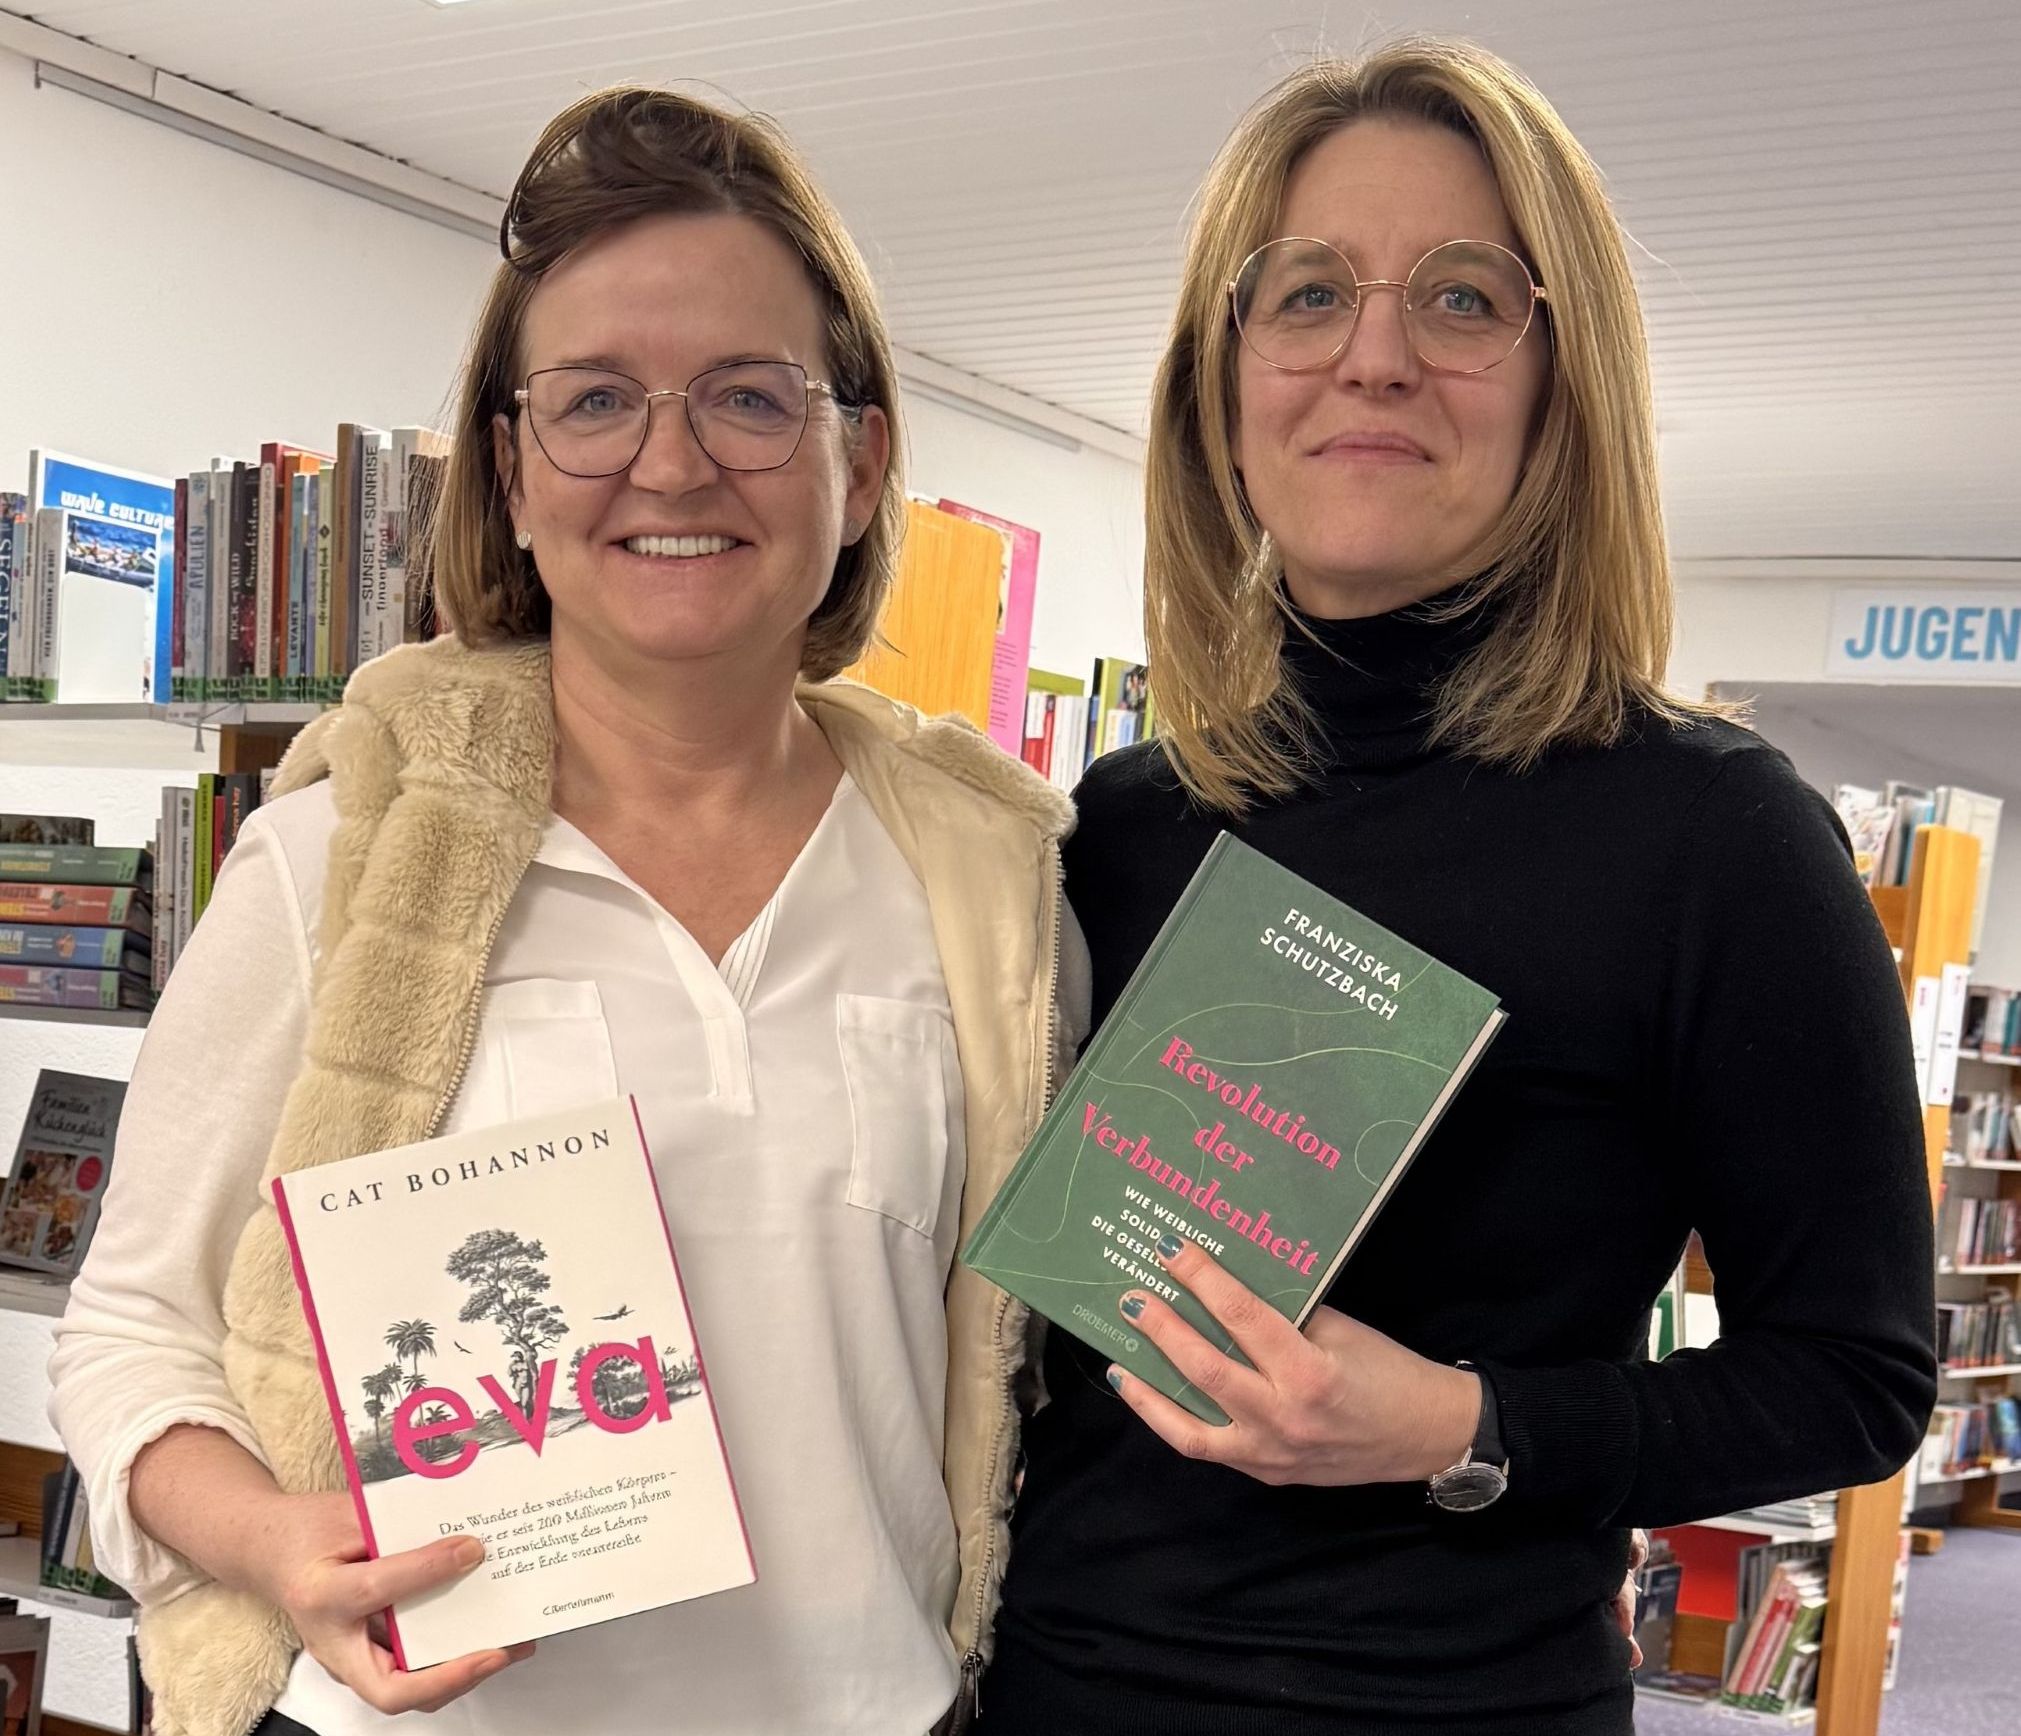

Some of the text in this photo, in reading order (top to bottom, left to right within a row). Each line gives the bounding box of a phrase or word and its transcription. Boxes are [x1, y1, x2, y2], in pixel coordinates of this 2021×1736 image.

[365, 445, 378, 519] SUNRISE
[189, 526, 205, 589] APULIEN
[231, 553, 240, 588] WILD
[362, 532, 374, 600] SUNSET
[289, 601, 299, 658] LEVANTE
[1845, 605, 2021, 661] JUGEN
[1259, 927, 1399, 1021] SCHUTZBACH
[1282, 908, 1402, 992] FRANZISKA
[1158, 1034, 1343, 1171] Revolution
[320, 1129, 610, 1212] CAT BOHANNON
[1192, 1121, 1256, 1175] der
[1079, 1101, 1321, 1277] Verbundenheit
[1091, 1215, 1116, 1236] DIE
[1120, 1209, 1161, 1241] SOLID
[1124, 1185, 1225, 1256] WIE WEIBLICHE
[1103, 1246, 1180, 1302] VERÄNDERT
[1072, 1303, 1127, 1344] DROEMER
[393, 1335, 672, 1479] eva
[439, 1522, 465, 1536] Das
[467, 1506, 518, 1528] Wunder
[523, 1502, 543, 1515] des
[479, 1532, 493, 1545] ie
[490, 1566, 512, 1581] auf
